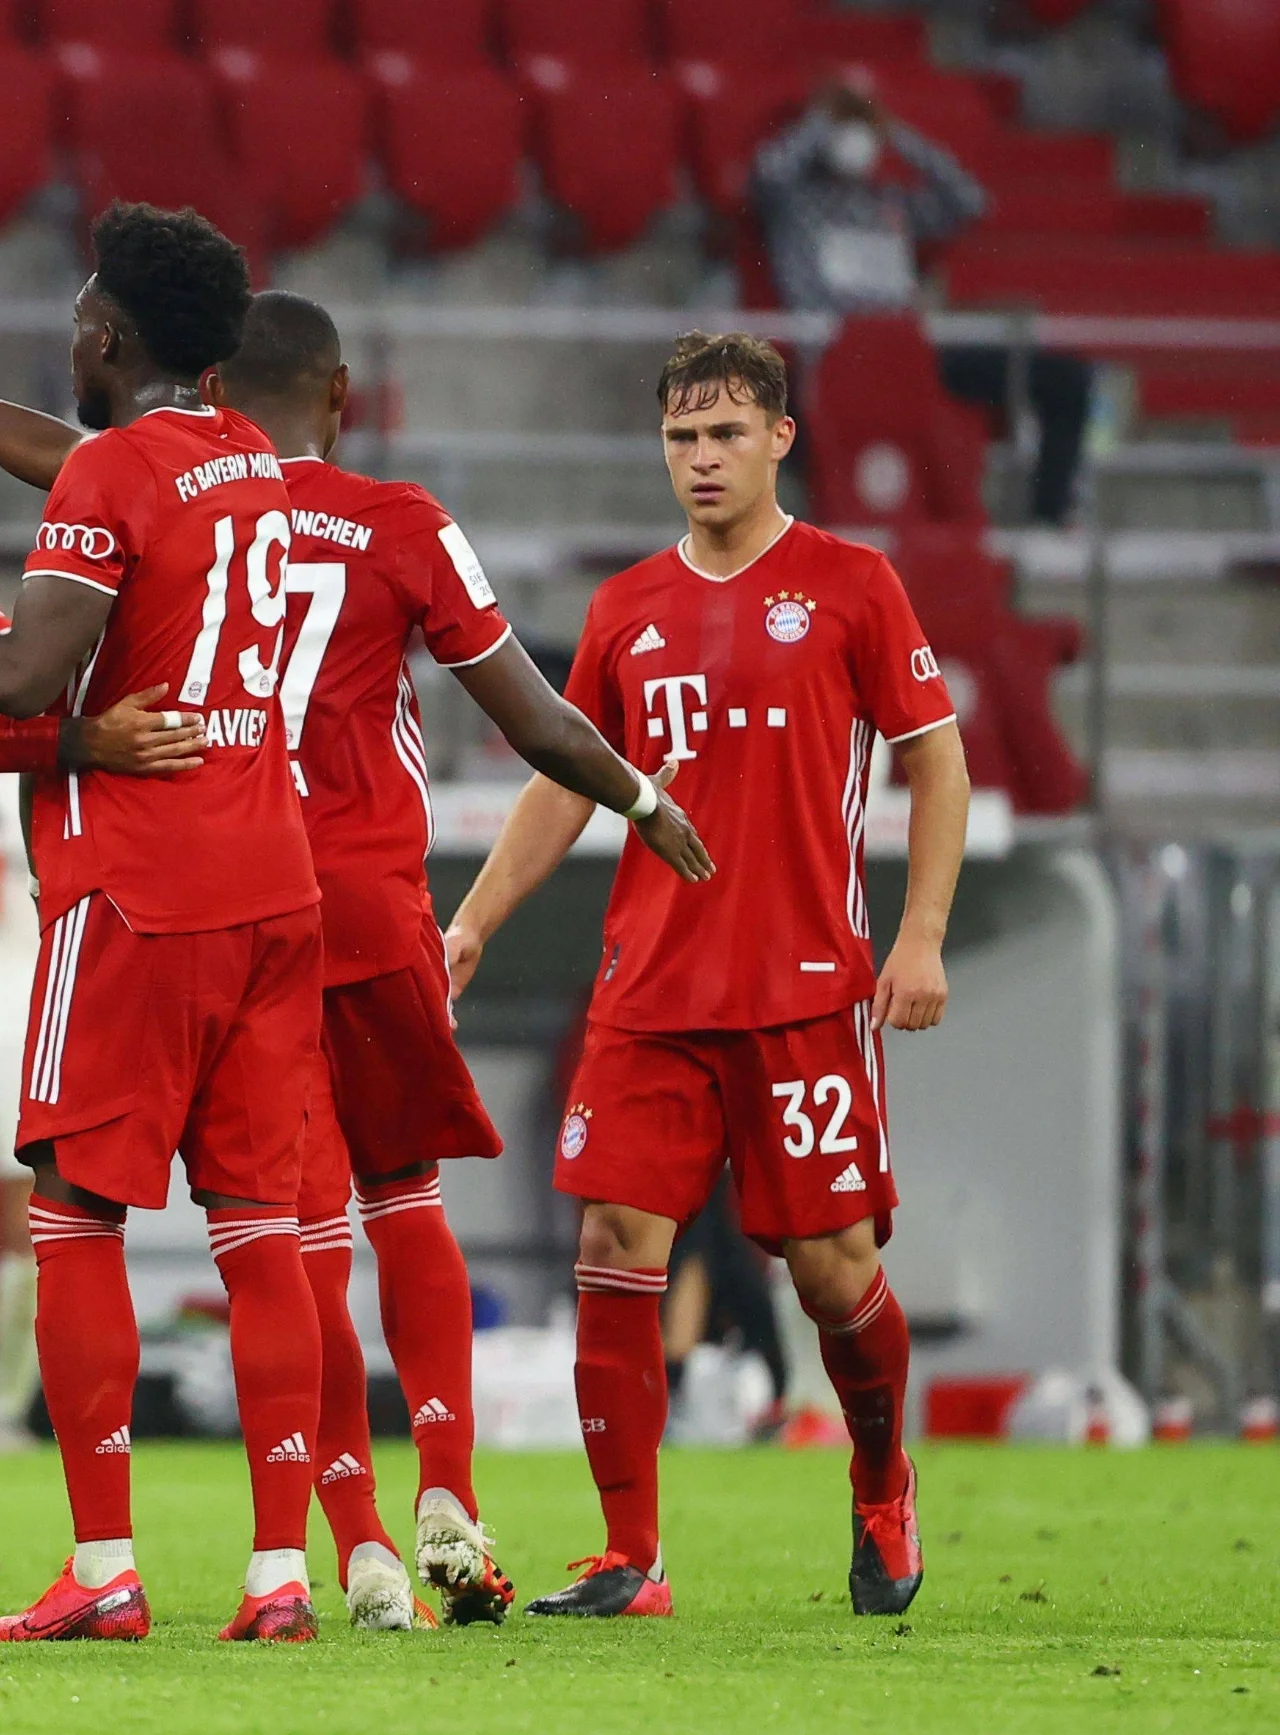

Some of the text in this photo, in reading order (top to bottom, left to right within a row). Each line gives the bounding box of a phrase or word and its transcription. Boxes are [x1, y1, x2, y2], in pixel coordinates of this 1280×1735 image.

[175, 472, 198, 502] FC
[193, 454, 248, 492] BAYERN
[291, 509, 372, 550] NCHEN
[178, 510, 291, 706] 19
[772, 1074, 858, 1158] 32
[830, 1180, 867, 1193] adidas
[413, 1412, 456, 1428] adidas
[580, 1418, 607, 1432] CB
[95, 1444, 131, 1454] adida
[266, 1451, 311, 1464] adidas
[322, 1466, 367, 1485] adidas
